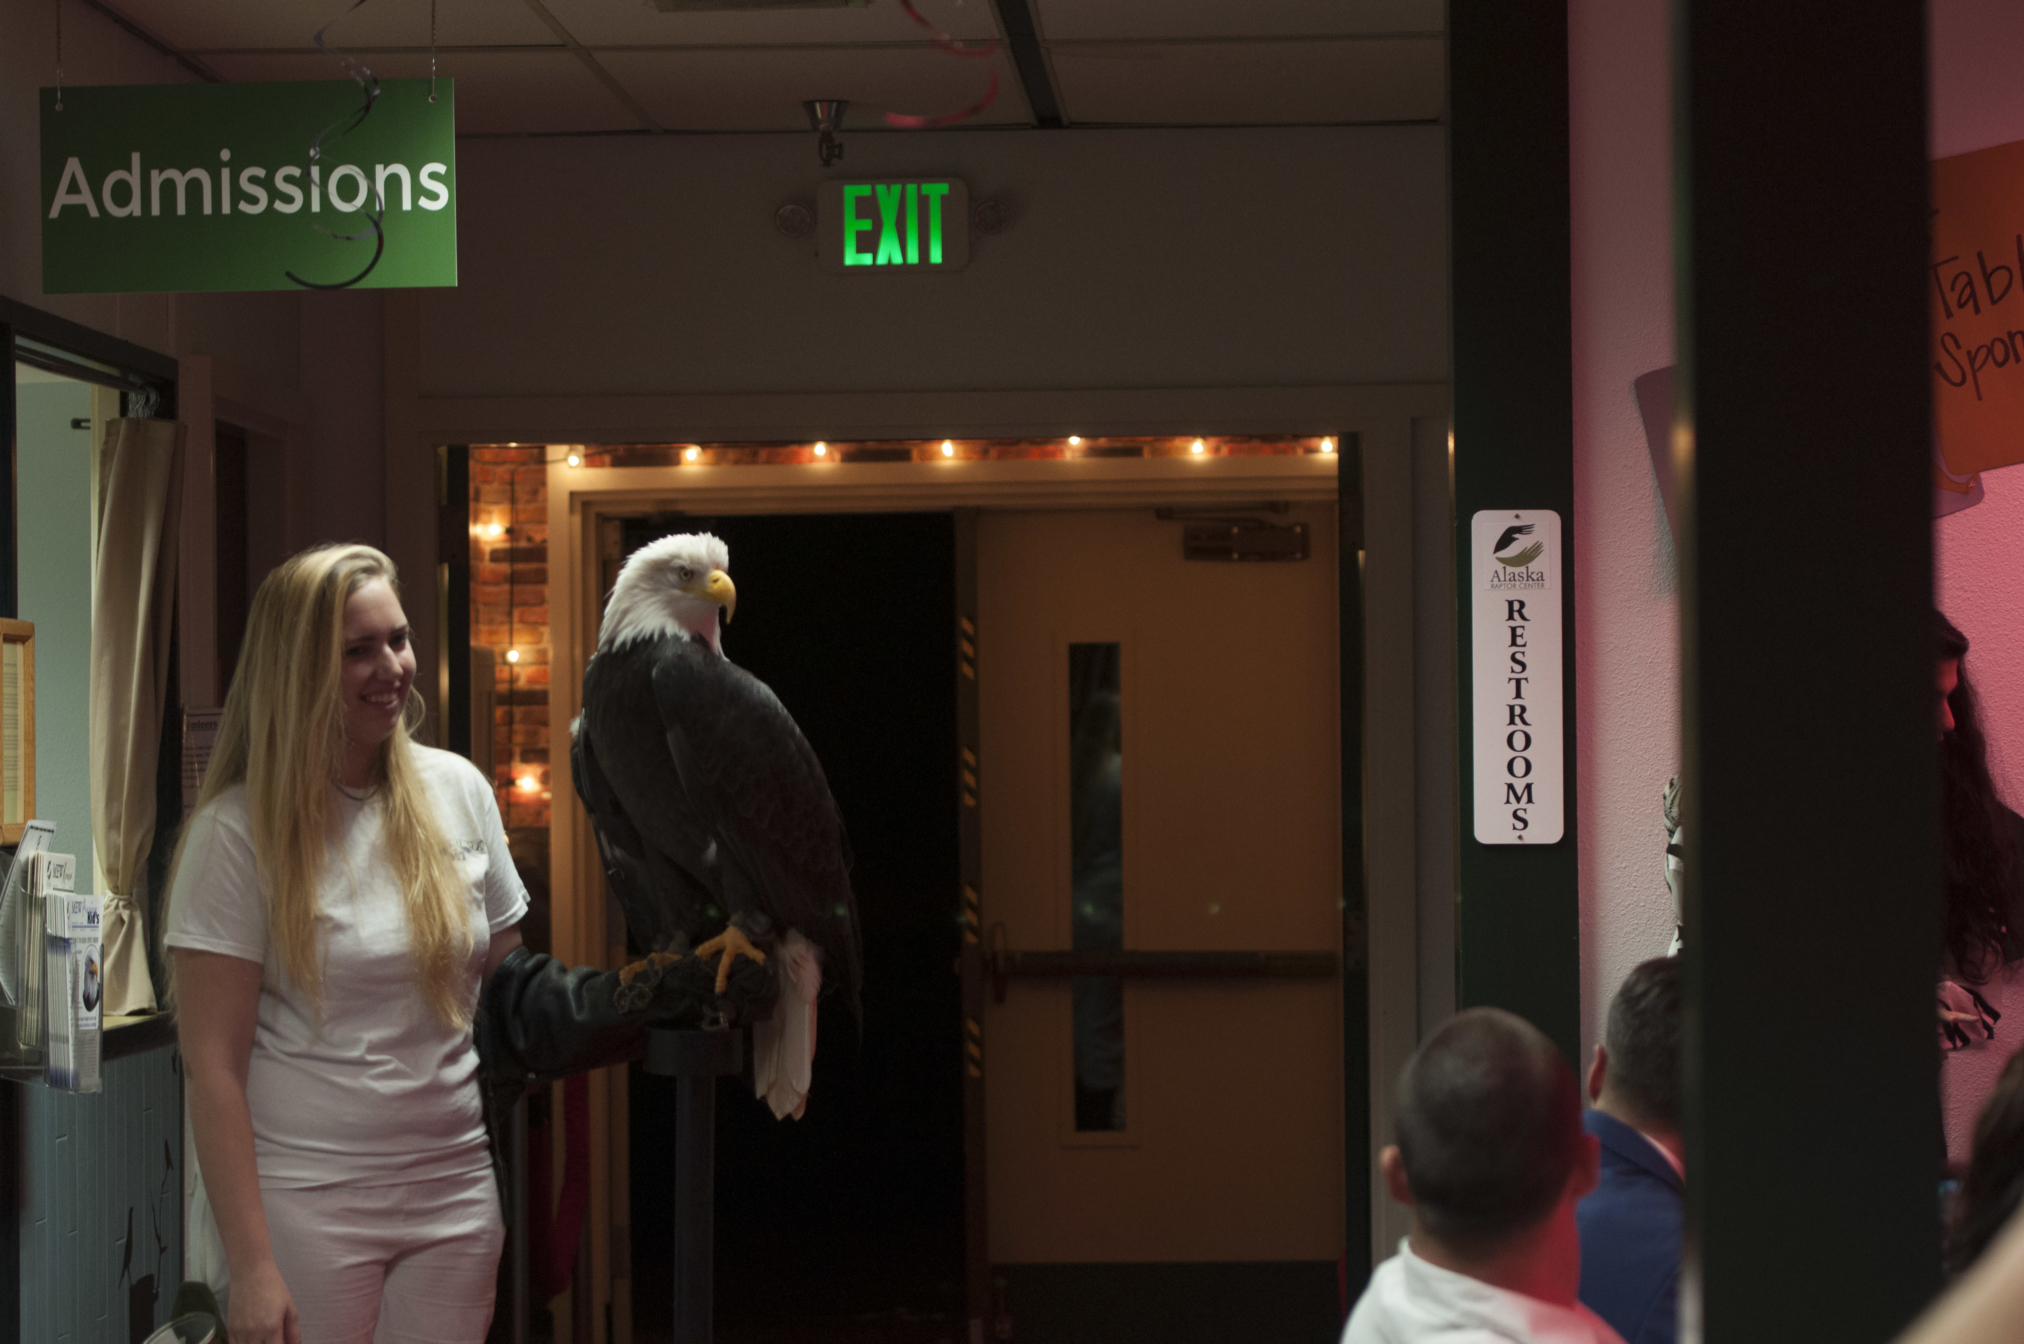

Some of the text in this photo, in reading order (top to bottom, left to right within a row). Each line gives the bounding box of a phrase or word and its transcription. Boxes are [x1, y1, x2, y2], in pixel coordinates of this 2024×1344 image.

[48, 147, 450, 219] Admissions
[843, 182, 950, 267] EXIT
[1490, 566, 1545, 582] Alaska
[1504, 599, 1535, 831] RESTROOMS
